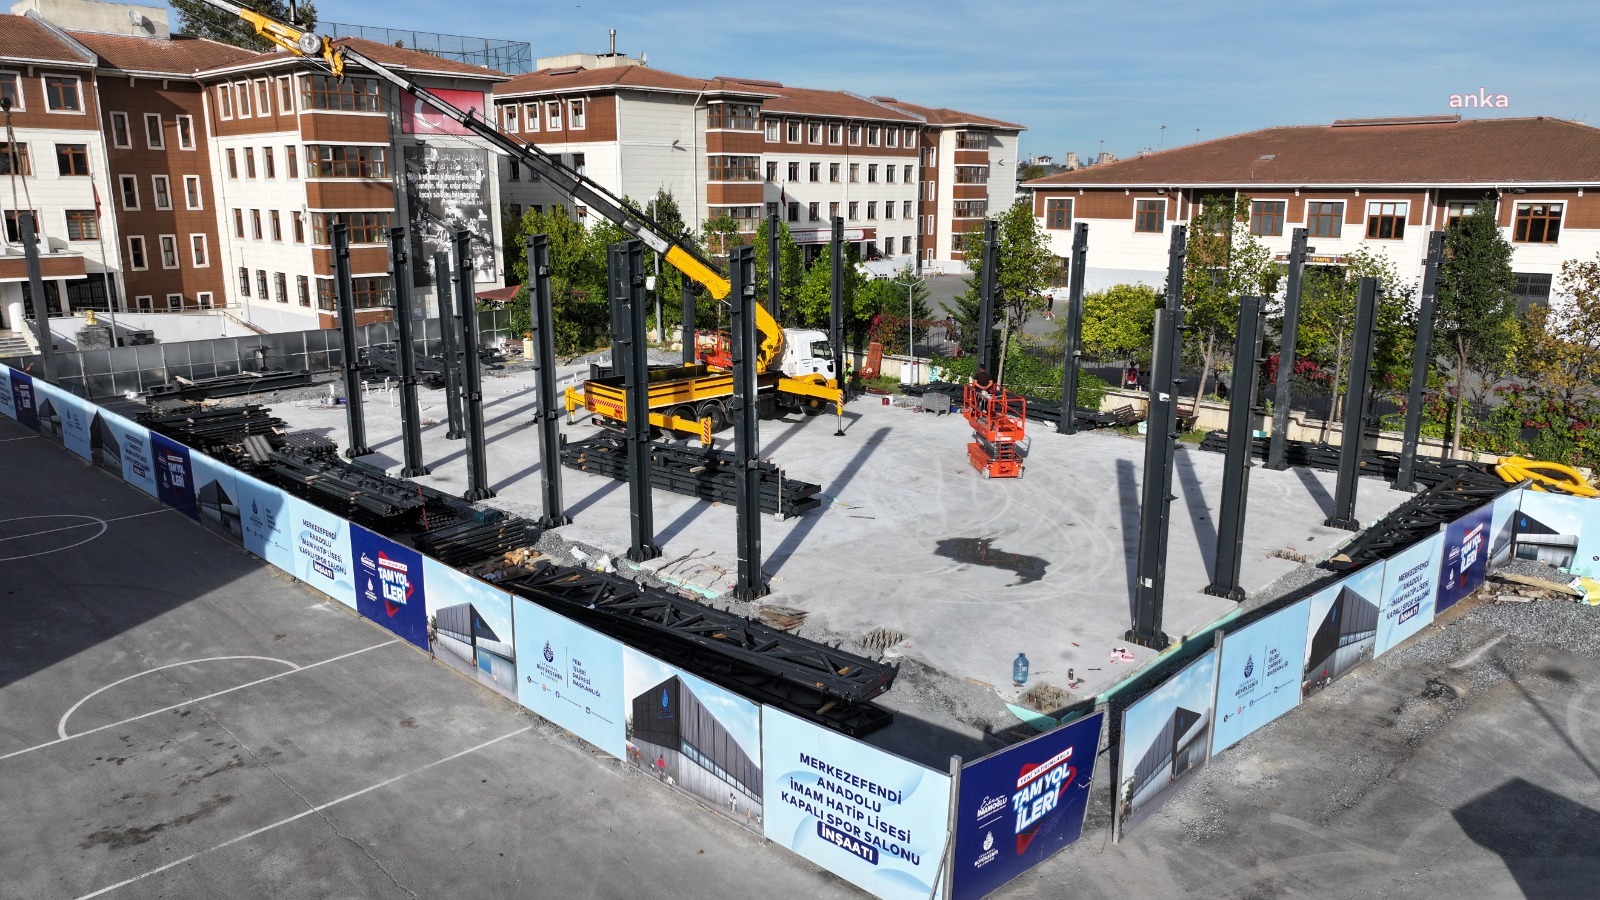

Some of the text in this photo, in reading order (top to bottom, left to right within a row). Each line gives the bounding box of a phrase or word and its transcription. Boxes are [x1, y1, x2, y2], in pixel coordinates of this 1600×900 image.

[378, 567, 410, 587] TAM YOL
[382, 579, 407, 605] İLERİ
[800, 752, 902, 805] MERKEZEFENDİ
[816, 776, 881, 813] ANADOLU
[1012, 762, 1070, 811] TAM YOL
[781, 791, 920, 866] KAPALI SPOR SALONU
[790, 776, 911, 844] İMAM HATİP LİSESİ
[1015, 781, 1061, 834] İLERİ
[821, 823, 873, 861] İNŞAATI
